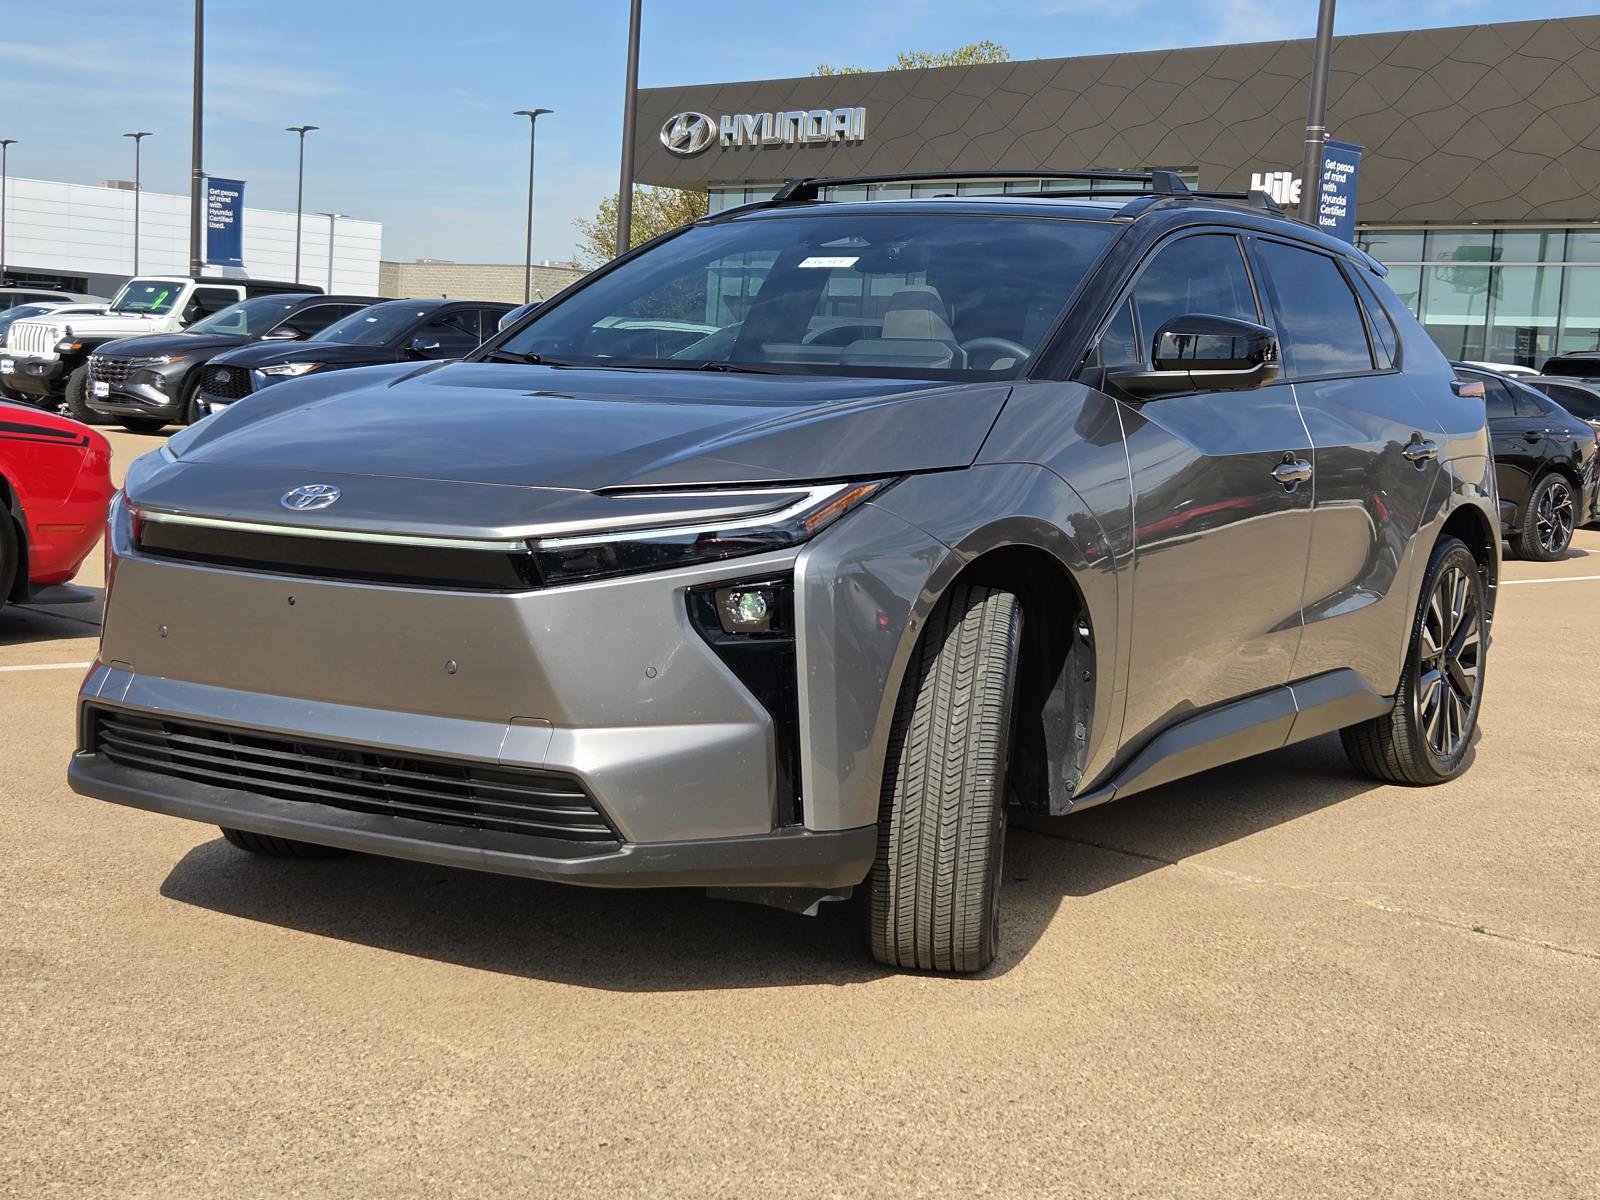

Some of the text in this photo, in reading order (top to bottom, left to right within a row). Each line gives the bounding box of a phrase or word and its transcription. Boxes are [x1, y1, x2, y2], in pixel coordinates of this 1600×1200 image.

[719, 107, 866, 147] HYUNDAI
[1325, 159, 1354, 173] Get peace
[1324, 171, 1347, 183] of mind
[1323, 182, 1336, 192] with
[1321, 193, 1347, 206] Hyundai
[1320, 204, 1346, 216] Certified
[209, 215, 233, 223] Certified
[1319, 215, 1337, 227] Used.
